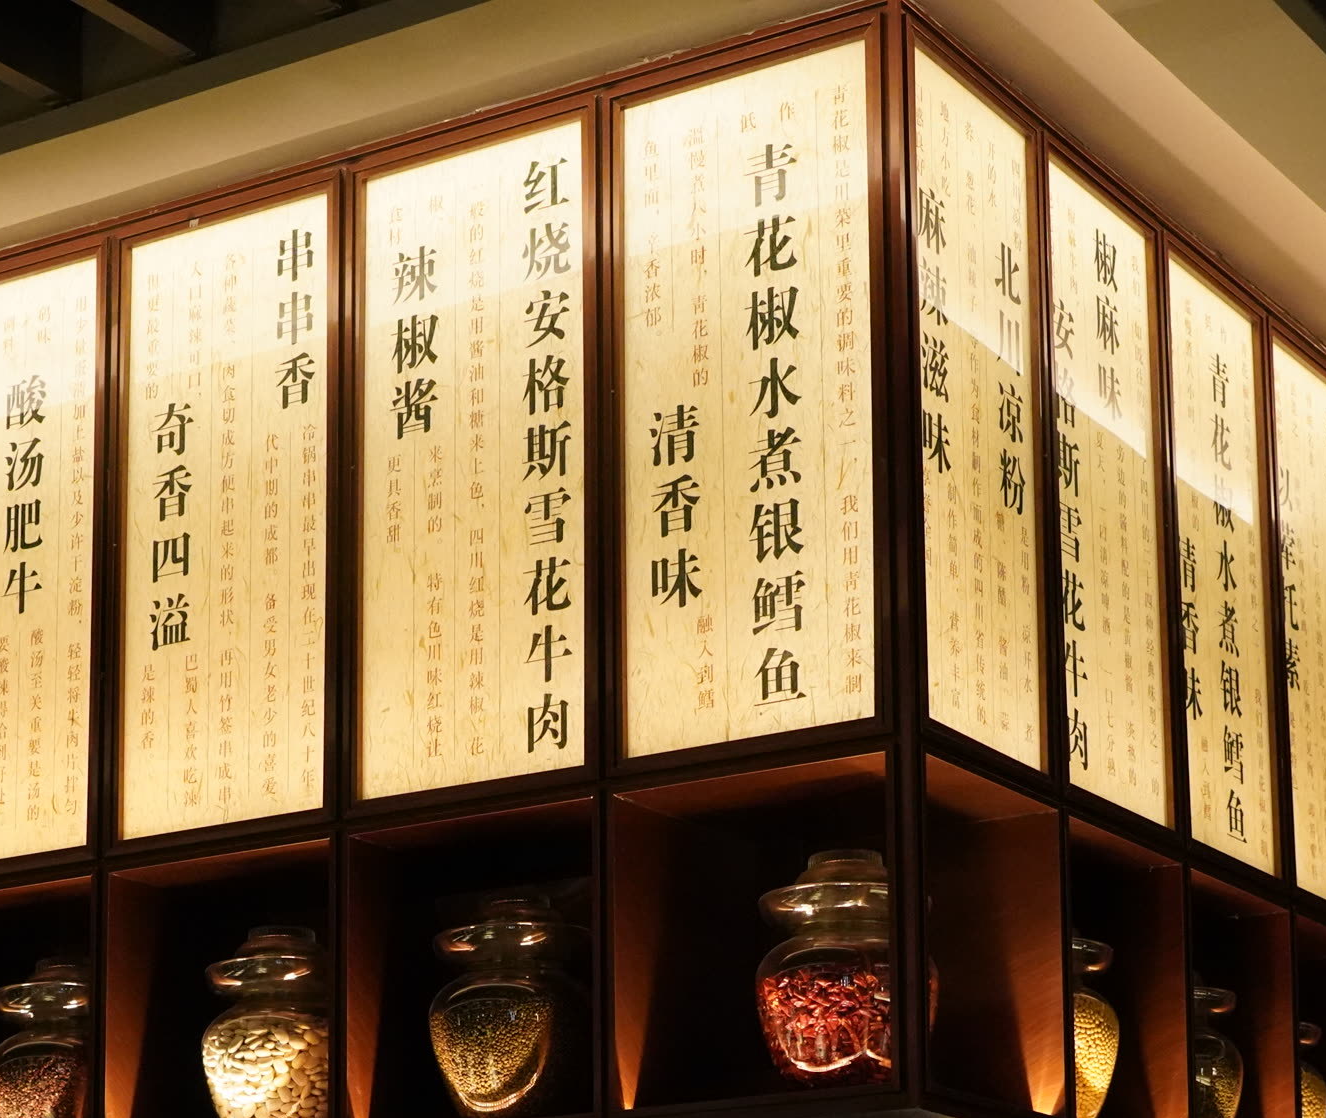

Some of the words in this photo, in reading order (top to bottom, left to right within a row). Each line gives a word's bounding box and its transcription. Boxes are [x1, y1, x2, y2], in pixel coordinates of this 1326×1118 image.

[740, 112, 757, 133] 低
[778, 101, 795, 121] 作
[276, 229, 316, 411] 串串香
[390, 246, 438, 440] 辣椒酱
[917, 187, 951, 473] 麻辣滋味
[995, 243, 1025, 515] 北川凉粉
[1094, 229, 1122, 421] 椒麻味
[1, 375, 47, 614] 酸汤肥牛
[149, 402, 195, 652] 奇香四溢
[386, 456, 402, 545] 更具香甜
[522, 158, 573, 753] 红烧安格斯雪花牛肉
[648, 404, 703, 608] 清香味
[744, 144, 807, 707] 青花椒水煮银鳕鱼
[1053, 299, 1088, 771] 安格斯雪花牛肉
[1209, 354, 1248, 843] 青花椒水煮银鳕鱼
[183, 653, 198, 808] 巴蜀人喜欢吃辣
[697, 614, 715, 711] 融入到鳕
